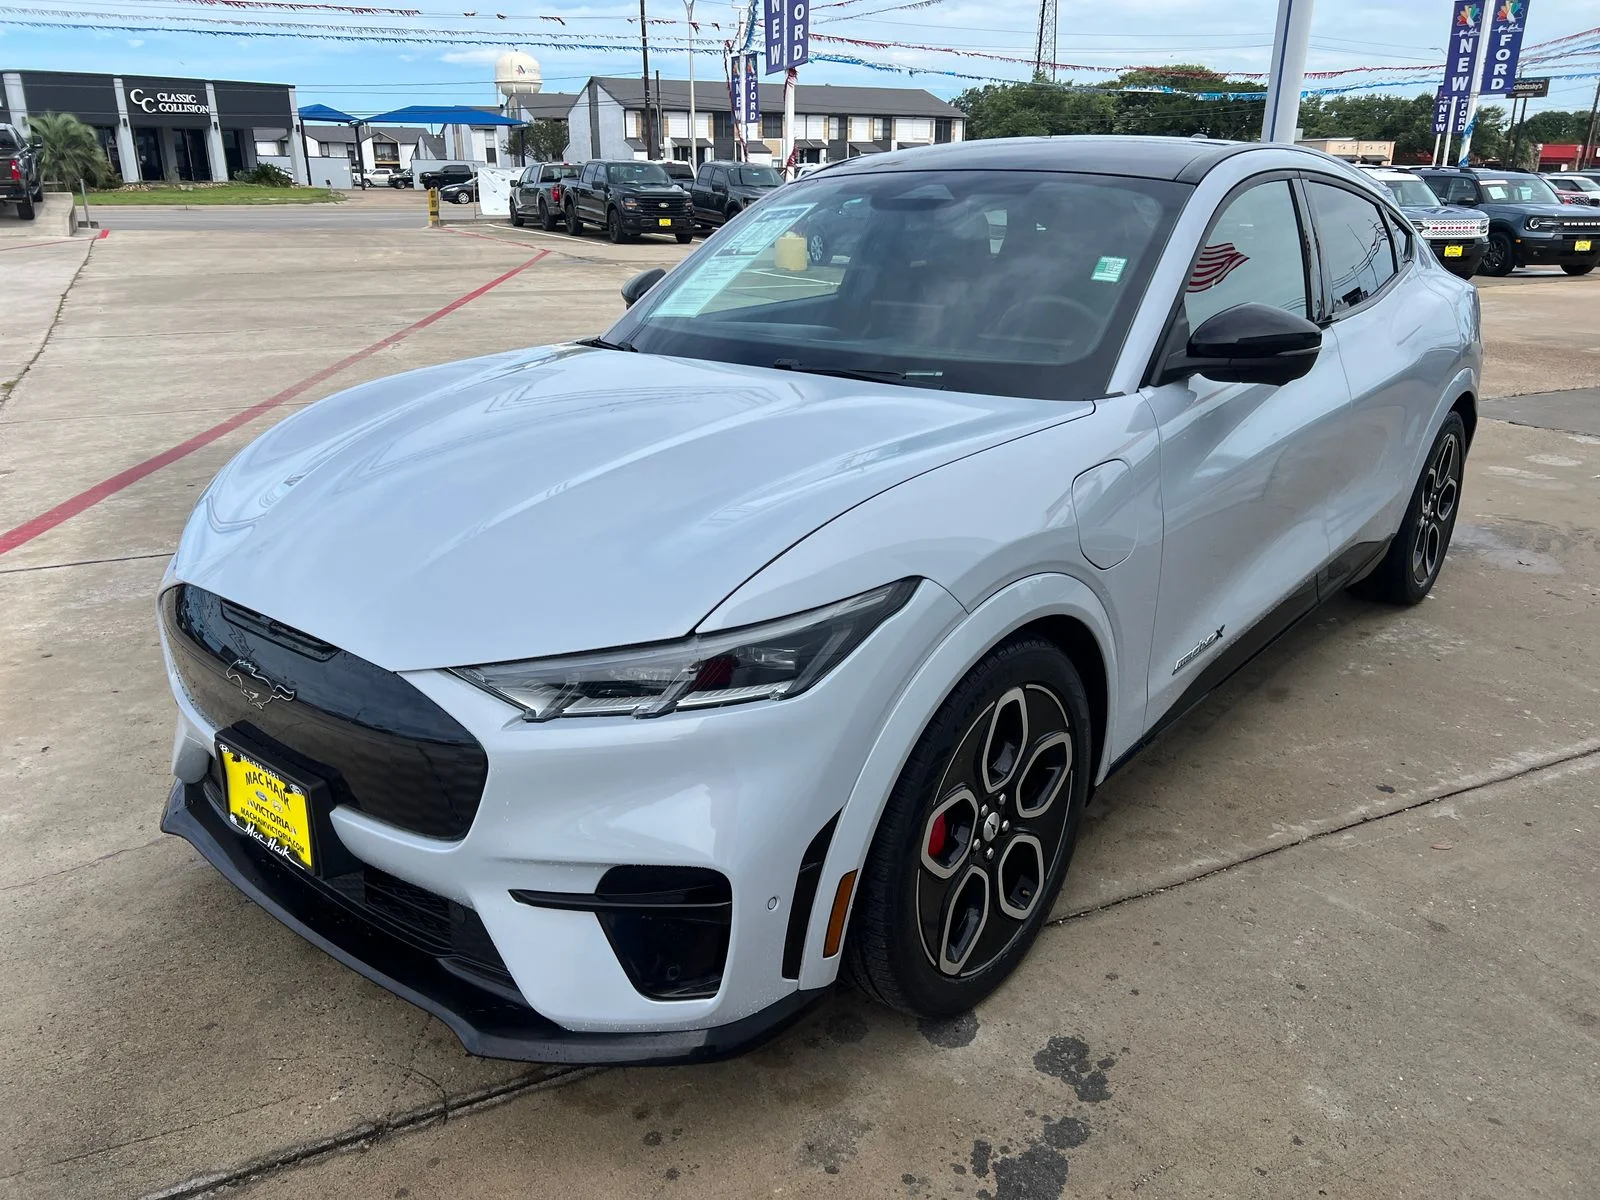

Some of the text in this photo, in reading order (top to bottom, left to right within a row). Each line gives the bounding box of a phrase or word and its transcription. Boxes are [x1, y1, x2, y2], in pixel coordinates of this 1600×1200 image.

[771, 0, 781, 65] NEW
[793, 3, 804, 60] ORD
[1452, 38, 1473, 91] NEW
[1490, 34, 1512, 90] FORD
[157, 93, 197, 103] CLASSIC
[1513, 83, 1543, 91] chlotzsky's
[158, 103, 210, 113] COLLISION
[1435, 104, 1447, 131] NEW
[1457, 102, 1467, 131] FORD
[245, 771, 264, 786] MAC
[252, 800, 291, 832] VICTORIA
[243, 822, 296, 862] Mac Haik
